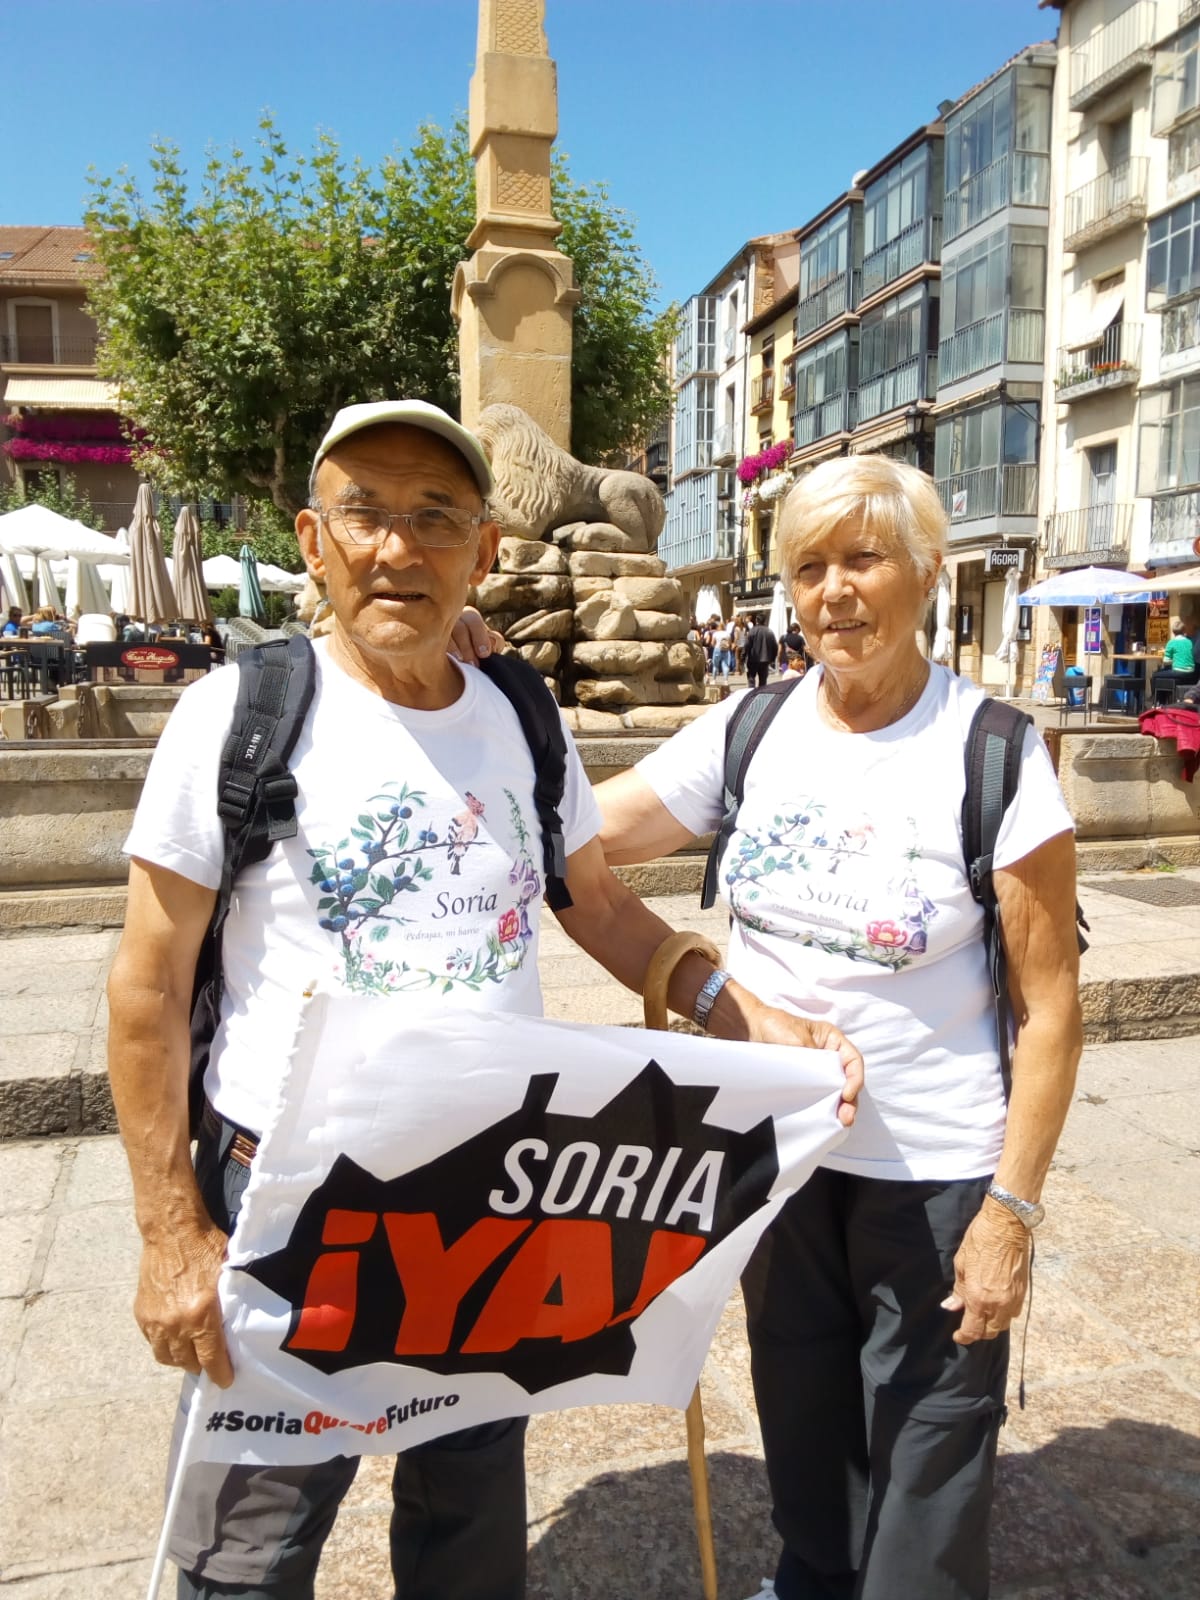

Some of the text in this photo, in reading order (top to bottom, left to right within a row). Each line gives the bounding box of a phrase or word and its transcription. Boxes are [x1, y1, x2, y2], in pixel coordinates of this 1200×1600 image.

[991, 551, 1019, 566] ÁGORA
[245, 733, 262, 760] HI-TEC
[431, 886, 498, 919] Soria
[798, 883, 869, 913] Soria
[488, 1137, 726, 1233] SORIA
[205, 1393, 461, 1436] #SoriaQureFuturo
